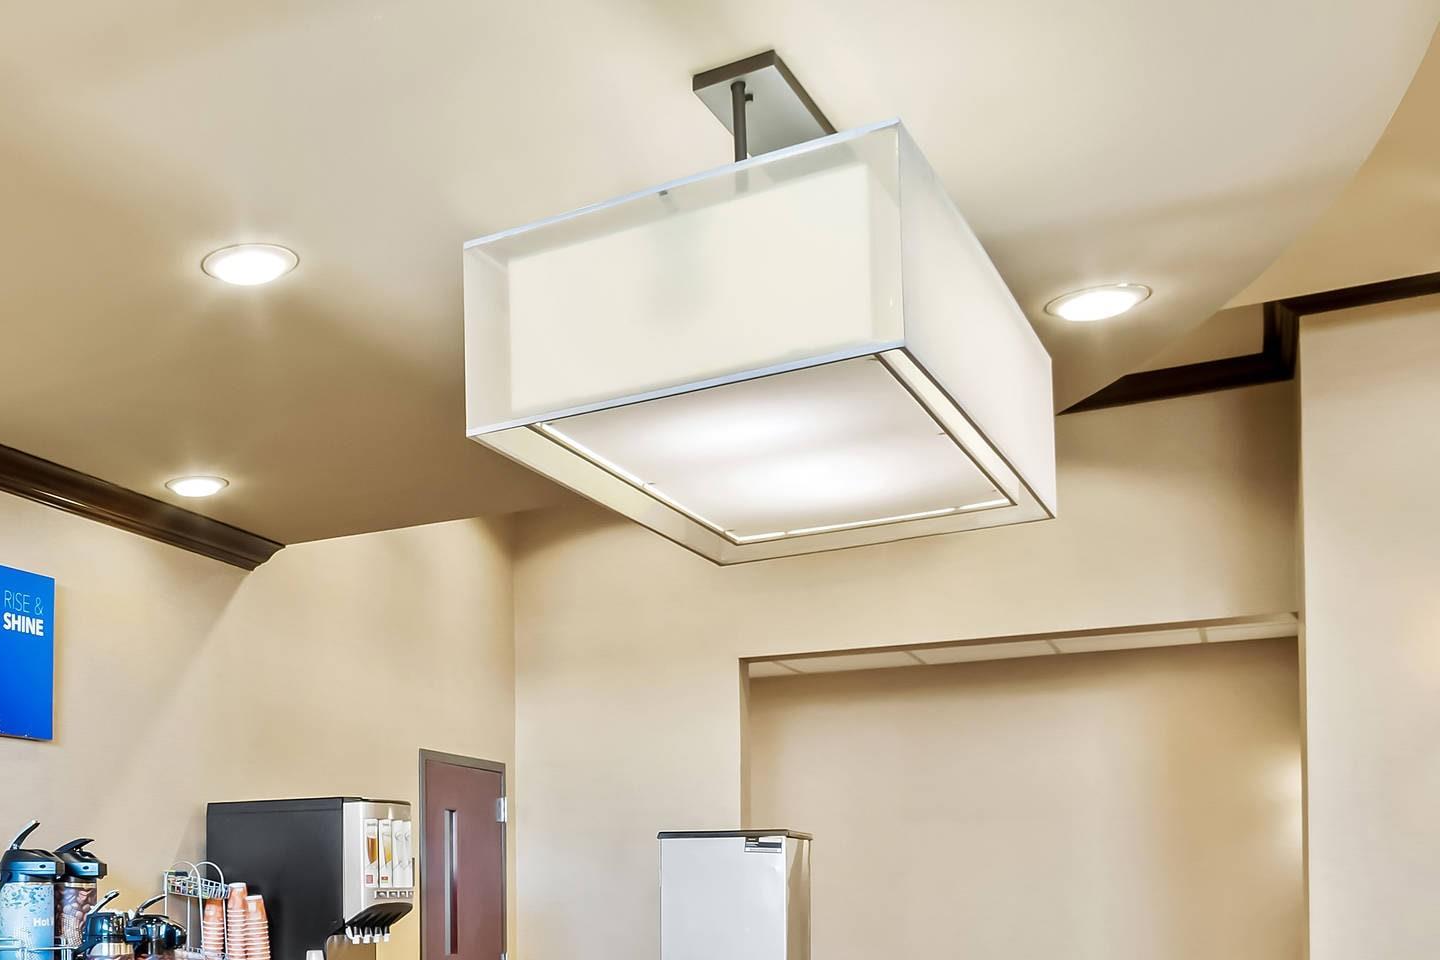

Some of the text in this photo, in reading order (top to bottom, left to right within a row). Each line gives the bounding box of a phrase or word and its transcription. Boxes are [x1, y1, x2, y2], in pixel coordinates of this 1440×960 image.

[4, 590, 44, 616] RISE &
[3, 611, 44, 637] SHINE
[32, 917, 51, 928] Hot
